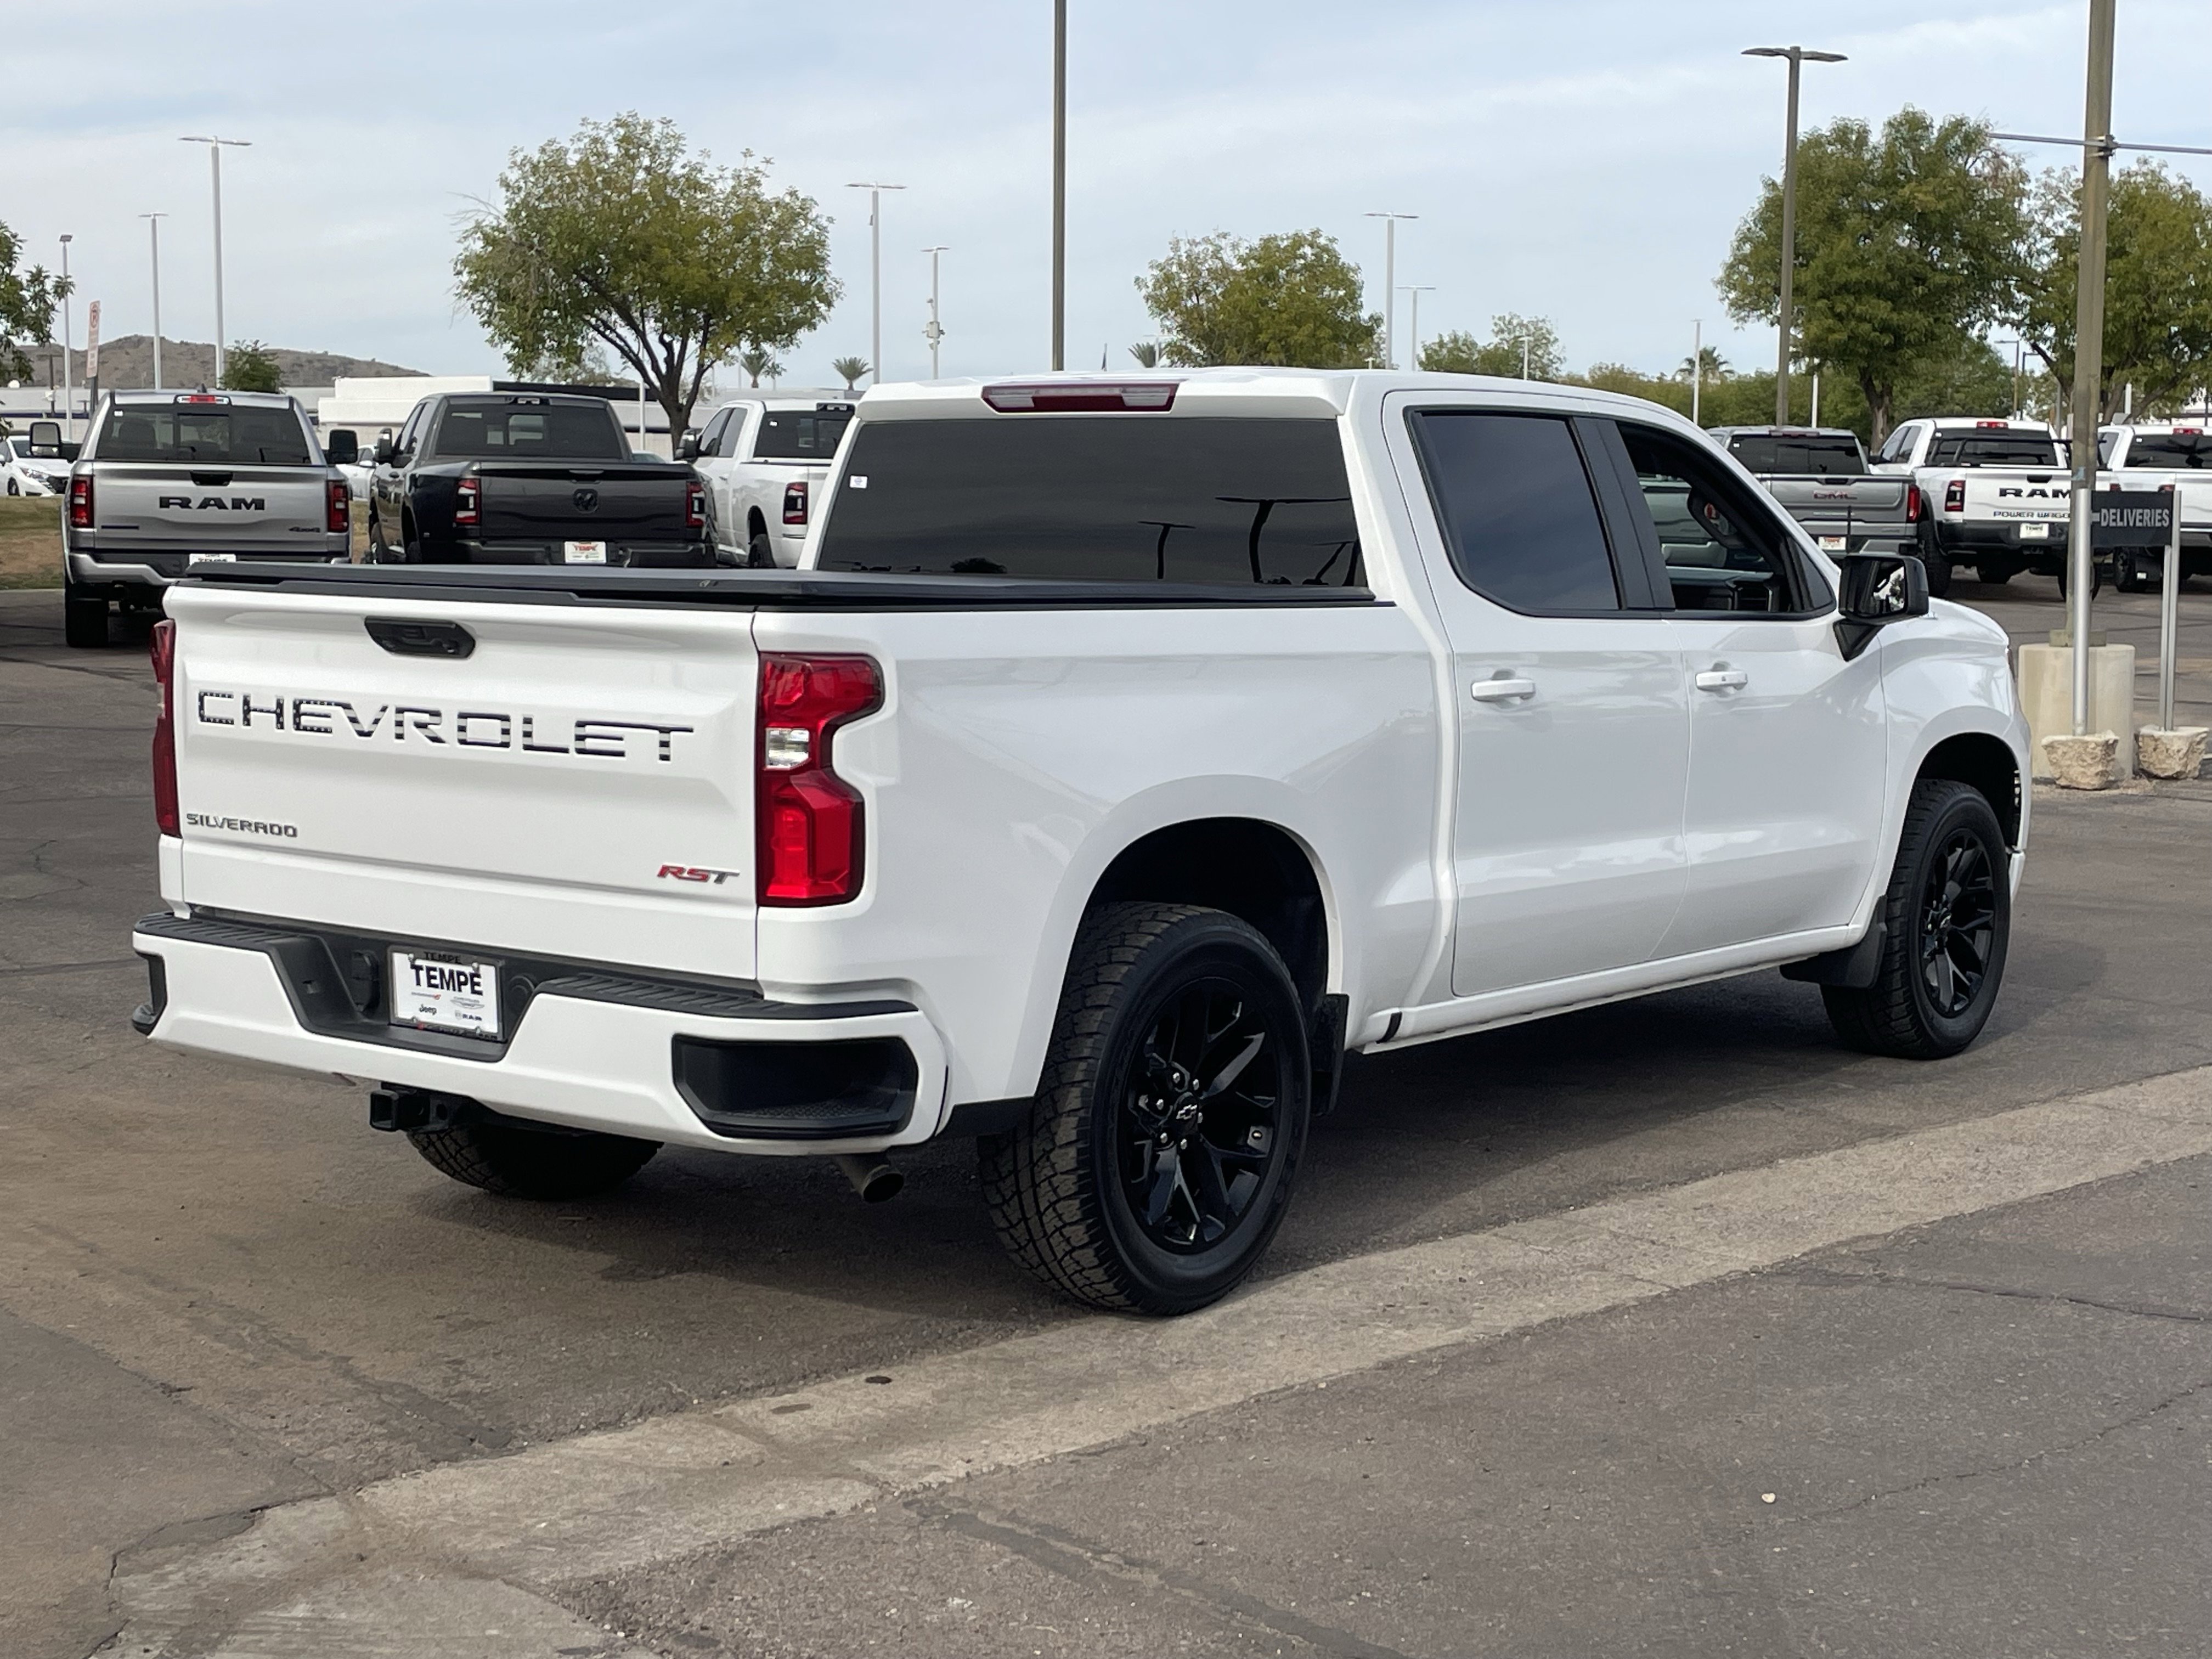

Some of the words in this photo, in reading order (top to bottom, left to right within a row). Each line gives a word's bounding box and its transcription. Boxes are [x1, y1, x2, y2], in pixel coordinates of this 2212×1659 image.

[159, 496, 266, 510] RAM
[1999, 488, 2071, 499] RAM
[2101, 508, 2170, 527] DELIVERIES
[198, 689, 694, 761] CHEVROLET
[187, 813, 297, 838] SILVERADO
[657, 864, 740, 885] RST
[424, 951, 462, 964] TEMPE
[411, 964, 483, 996] TEMPE
[419, 1004, 437, 1015] Jeep
